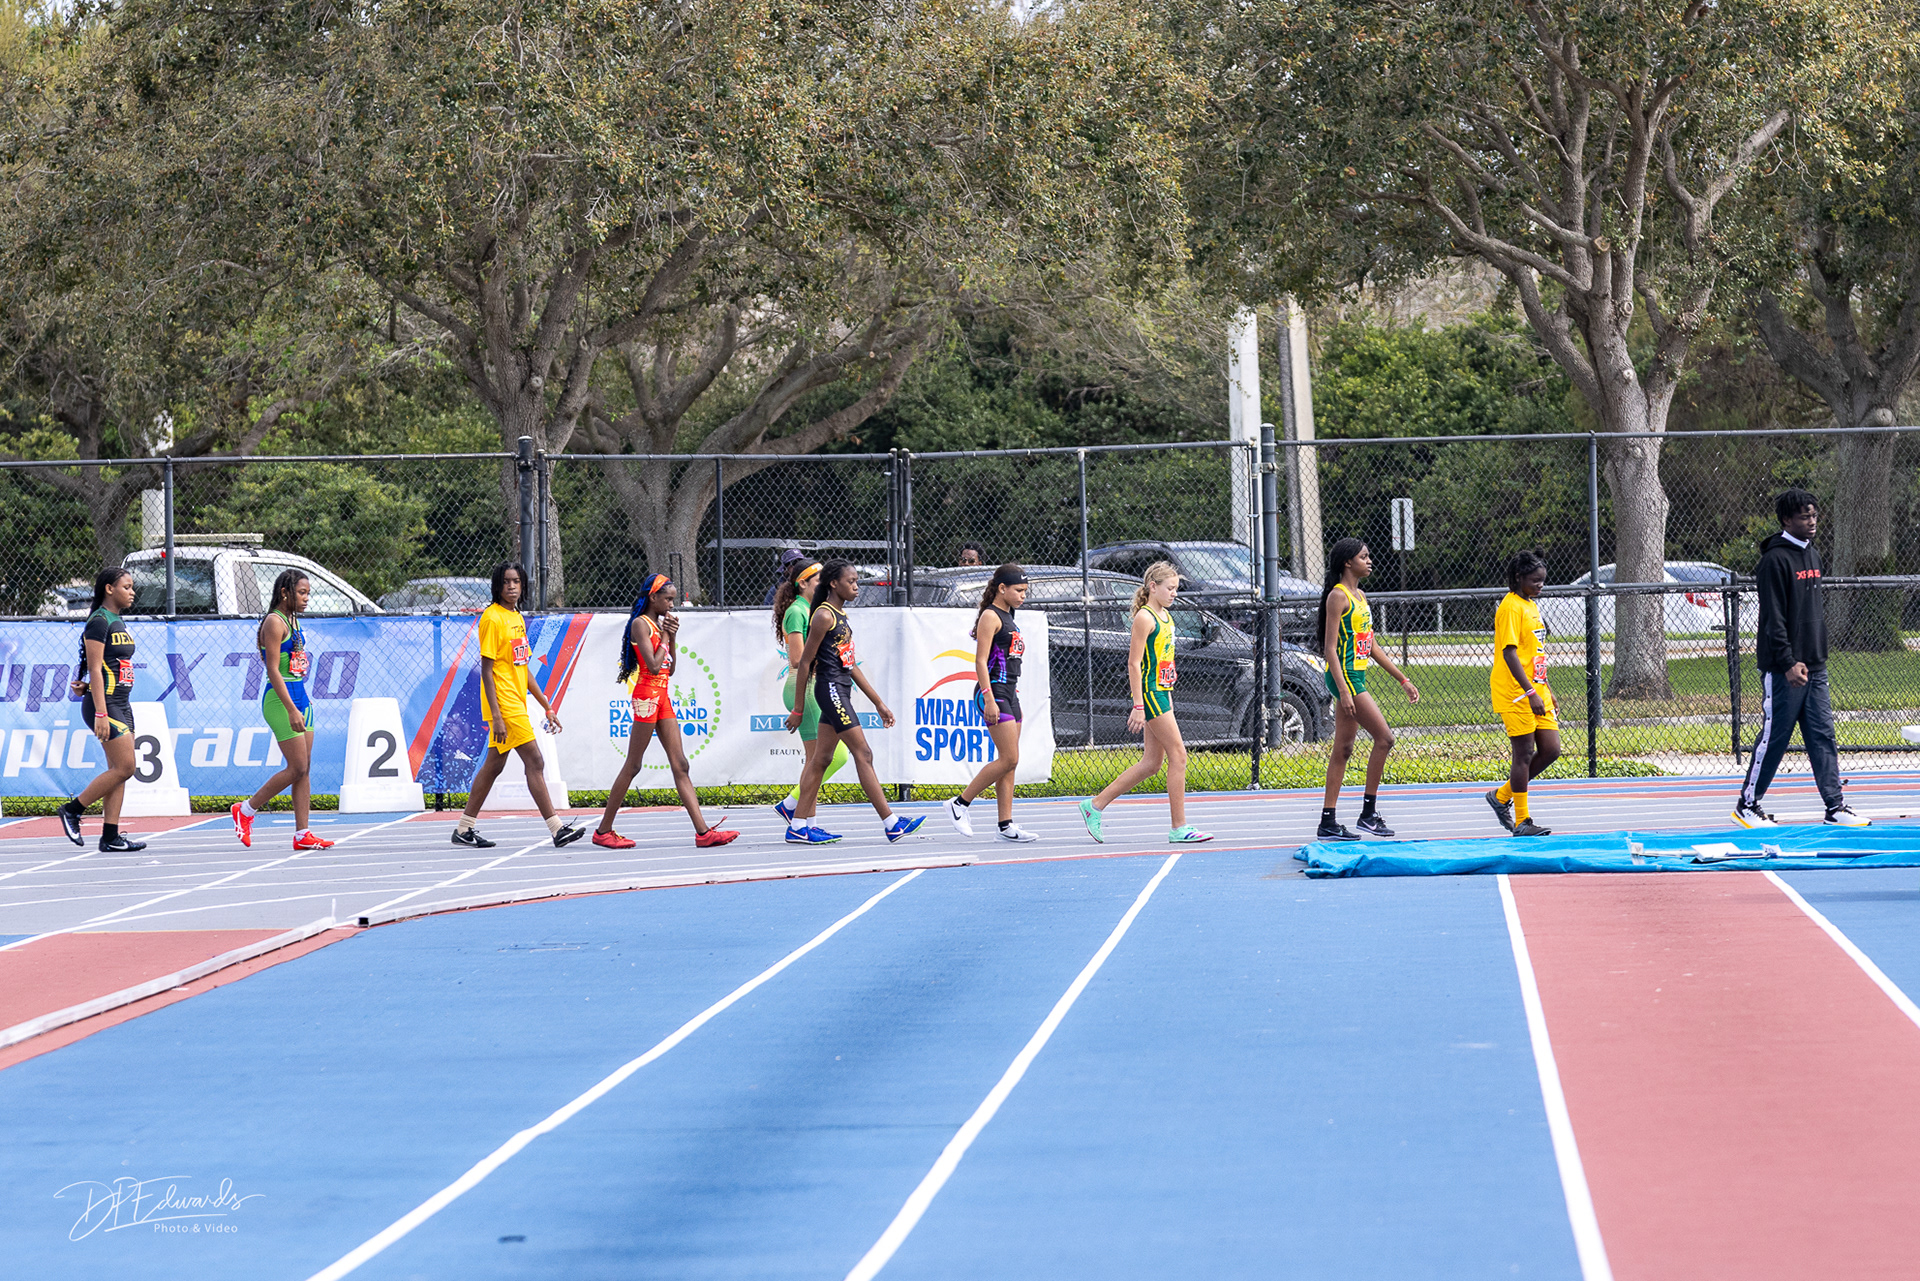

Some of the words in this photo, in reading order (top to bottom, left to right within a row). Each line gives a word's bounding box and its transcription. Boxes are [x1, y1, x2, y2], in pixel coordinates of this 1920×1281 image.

[156, 652, 206, 701] X
[609, 700, 632, 708] CITY
[915, 697, 987, 727] MIRAM
[134, 735, 163, 783] 3
[367, 730, 399, 778] 2
[770, 748, 802, 756] BEAUTY
[915, 727, 996, 762] SPORT
